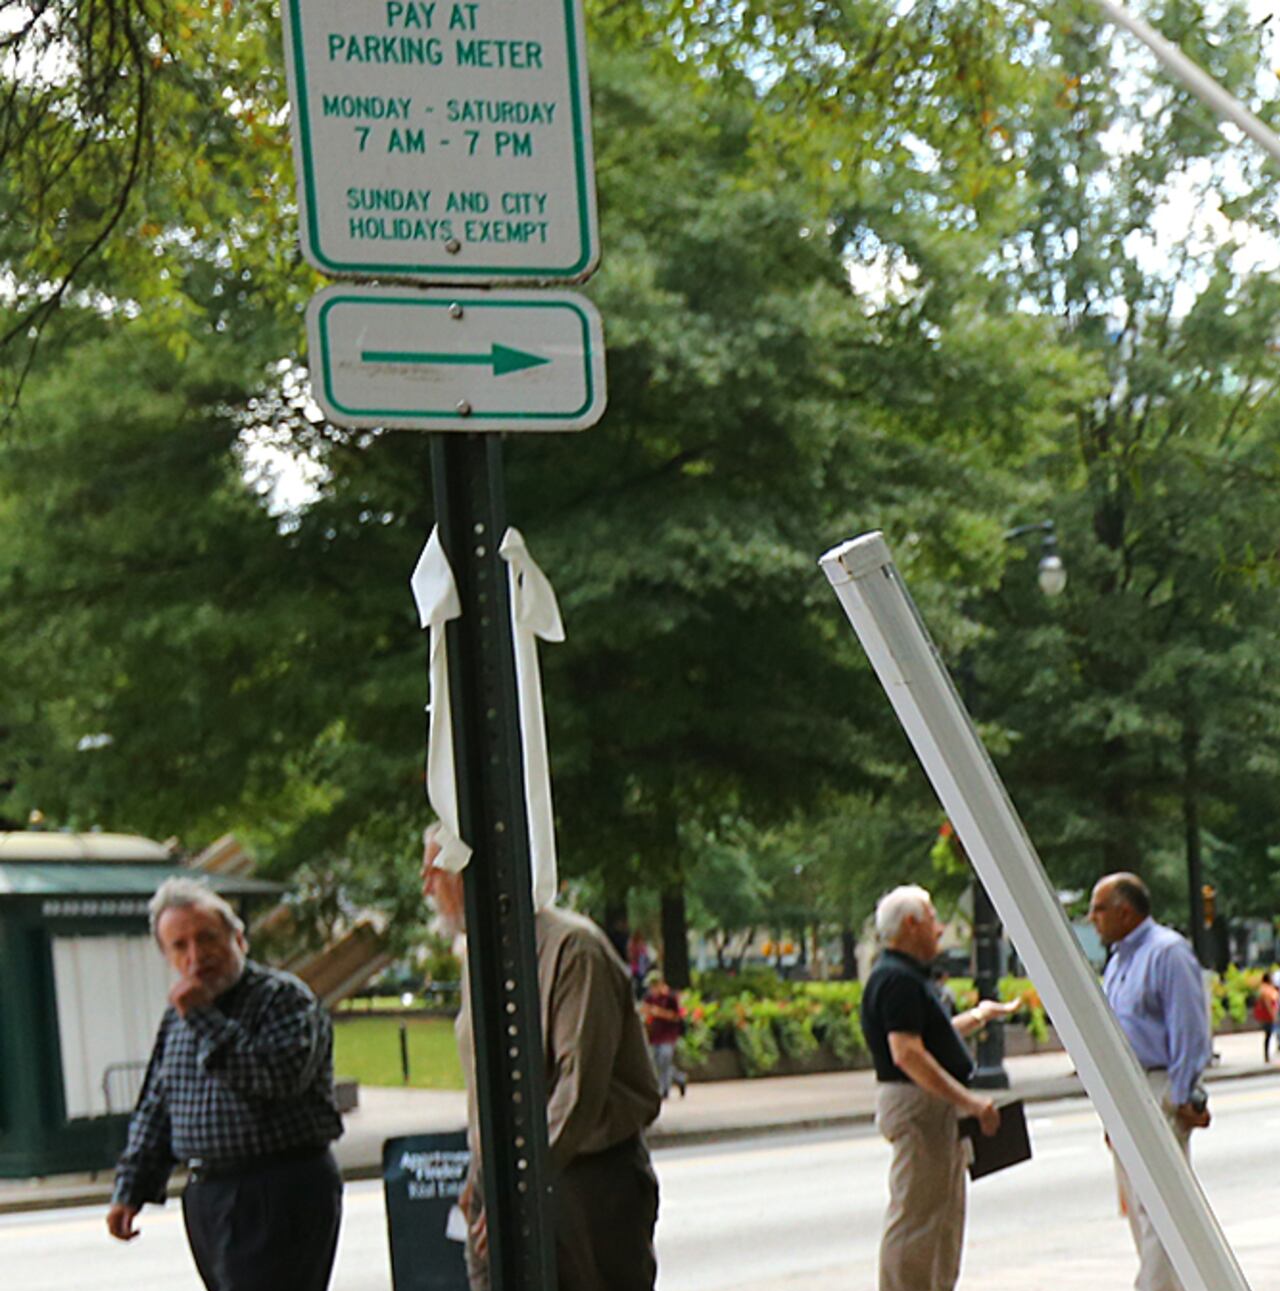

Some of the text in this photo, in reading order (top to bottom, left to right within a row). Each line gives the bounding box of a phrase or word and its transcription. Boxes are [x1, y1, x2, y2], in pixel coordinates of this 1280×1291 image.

[386, 1, 479, 31] PAY AT
[328, 34, 542, 69] PARKING METER
[322, 94, 411, 120] MONDAY
[447, 100, 556, 124] SATURDAY
[354, 126, 371, 153] 7
[388, 128, 426, 154] AM
[464, 130, 480, 156] 7
[494, 131, 532, 157] PM
[346, 188, 547, 215] SUNDAY AND CITY
[349, 217, 548, 243] HOLIDAYS EXEMPT
